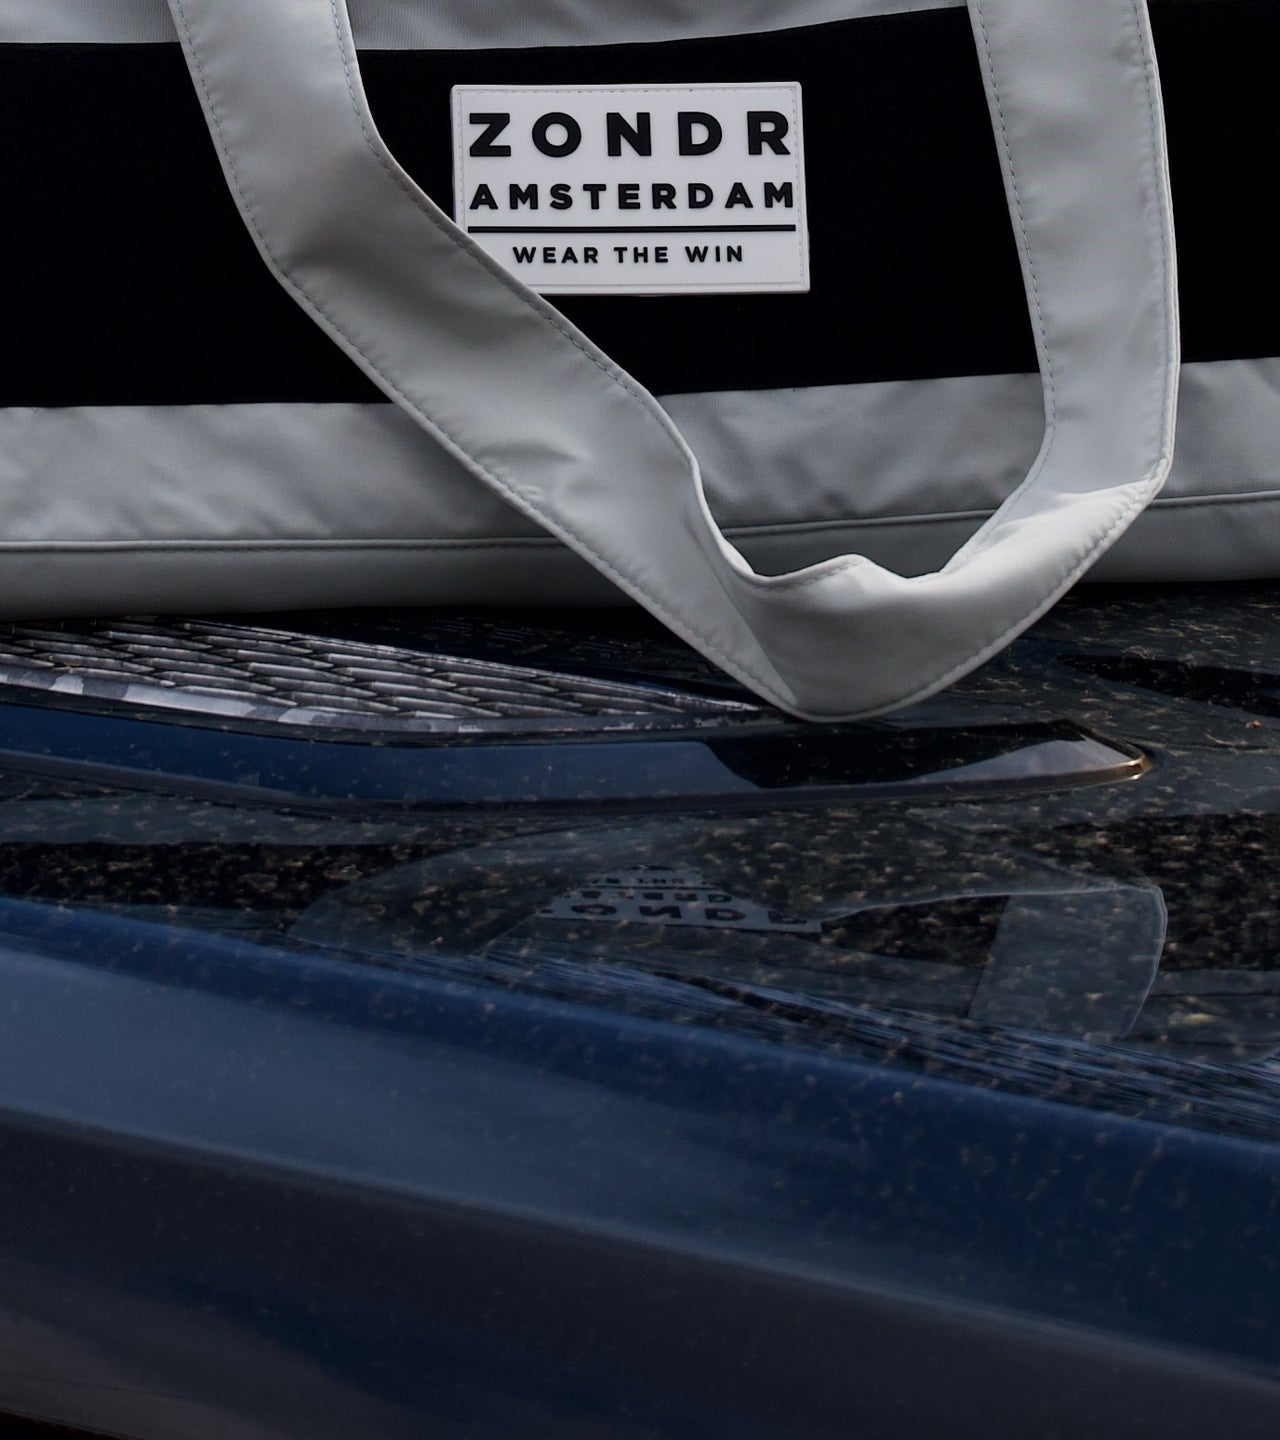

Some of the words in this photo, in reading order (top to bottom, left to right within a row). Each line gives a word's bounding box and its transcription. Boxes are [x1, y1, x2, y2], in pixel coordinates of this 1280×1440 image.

[468, 110, 791, 158] ZONDR
[469, 182, 794, 211] AMSTERDAM
[512, 246, 599, 264] WEAR
[613, 246, 669, 264] THE
[684, 245, 743, 263] WIN
